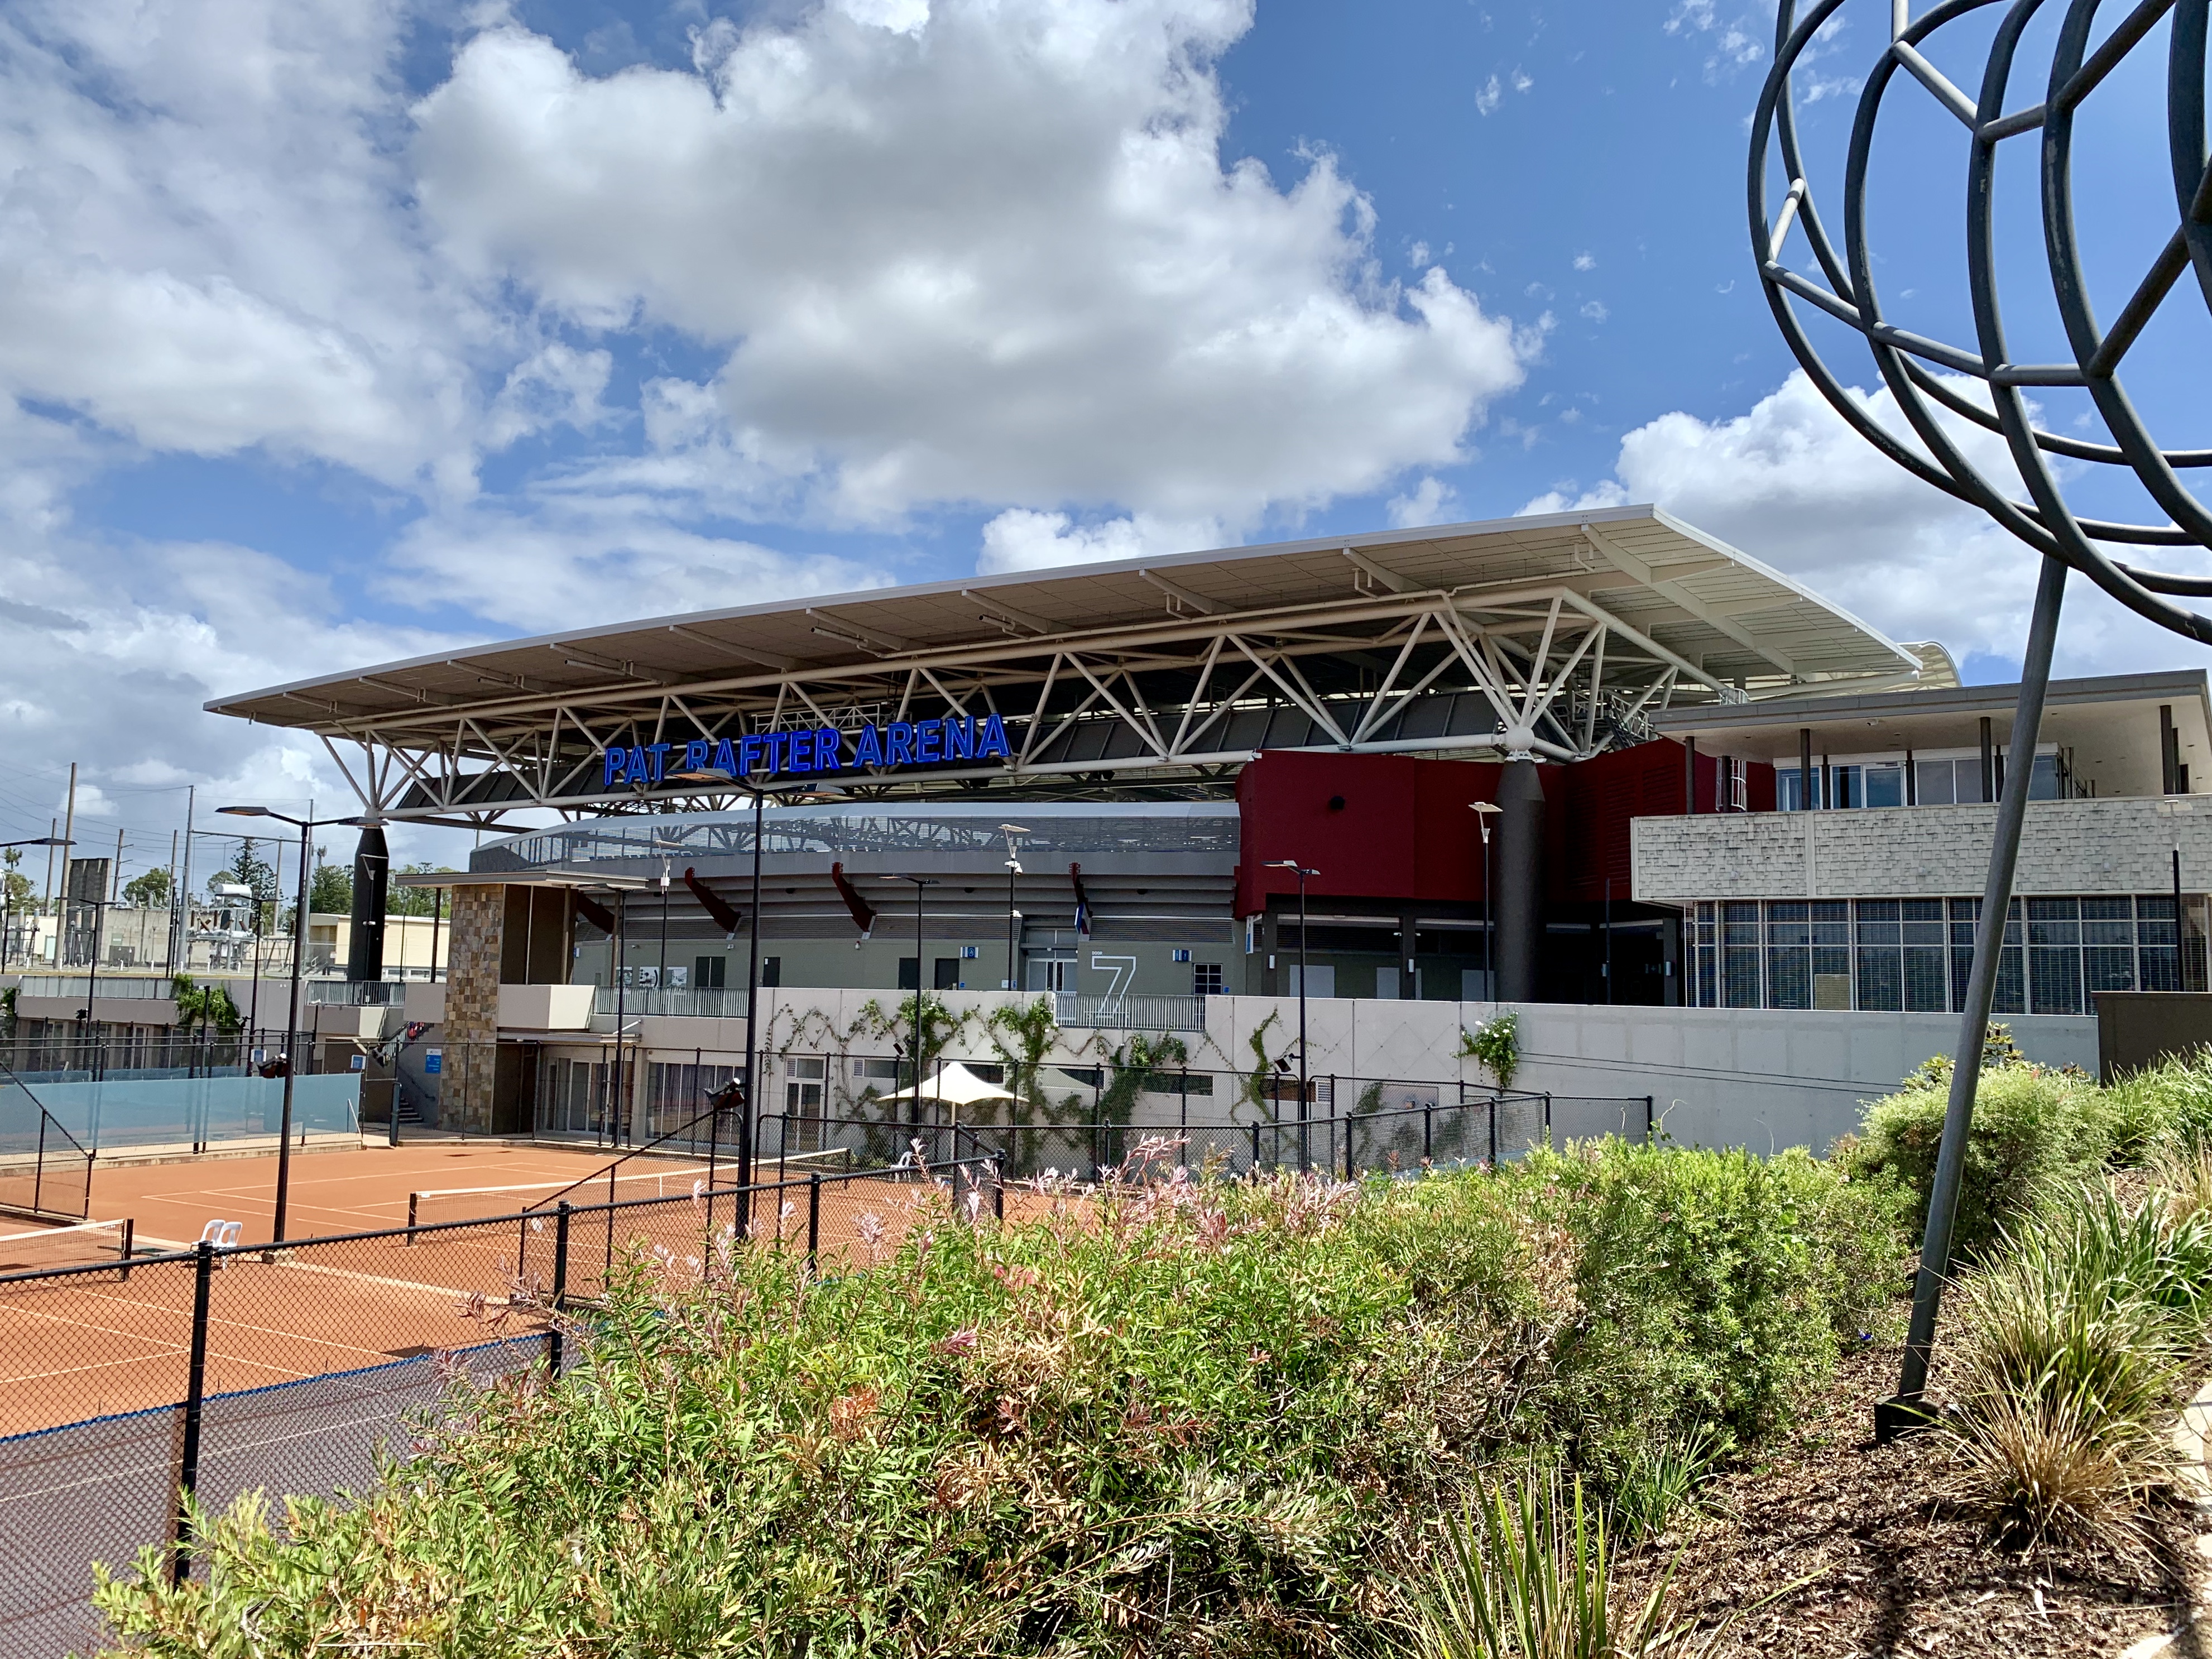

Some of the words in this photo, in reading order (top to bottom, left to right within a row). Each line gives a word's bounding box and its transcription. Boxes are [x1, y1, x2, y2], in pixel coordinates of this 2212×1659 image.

[604, 743, 670, 786] PAT
[687, 728, 839, 777] RAFTER
[853, 713, 1011, 768] ARENA
[1091, 956, 1136, 1018] 7
